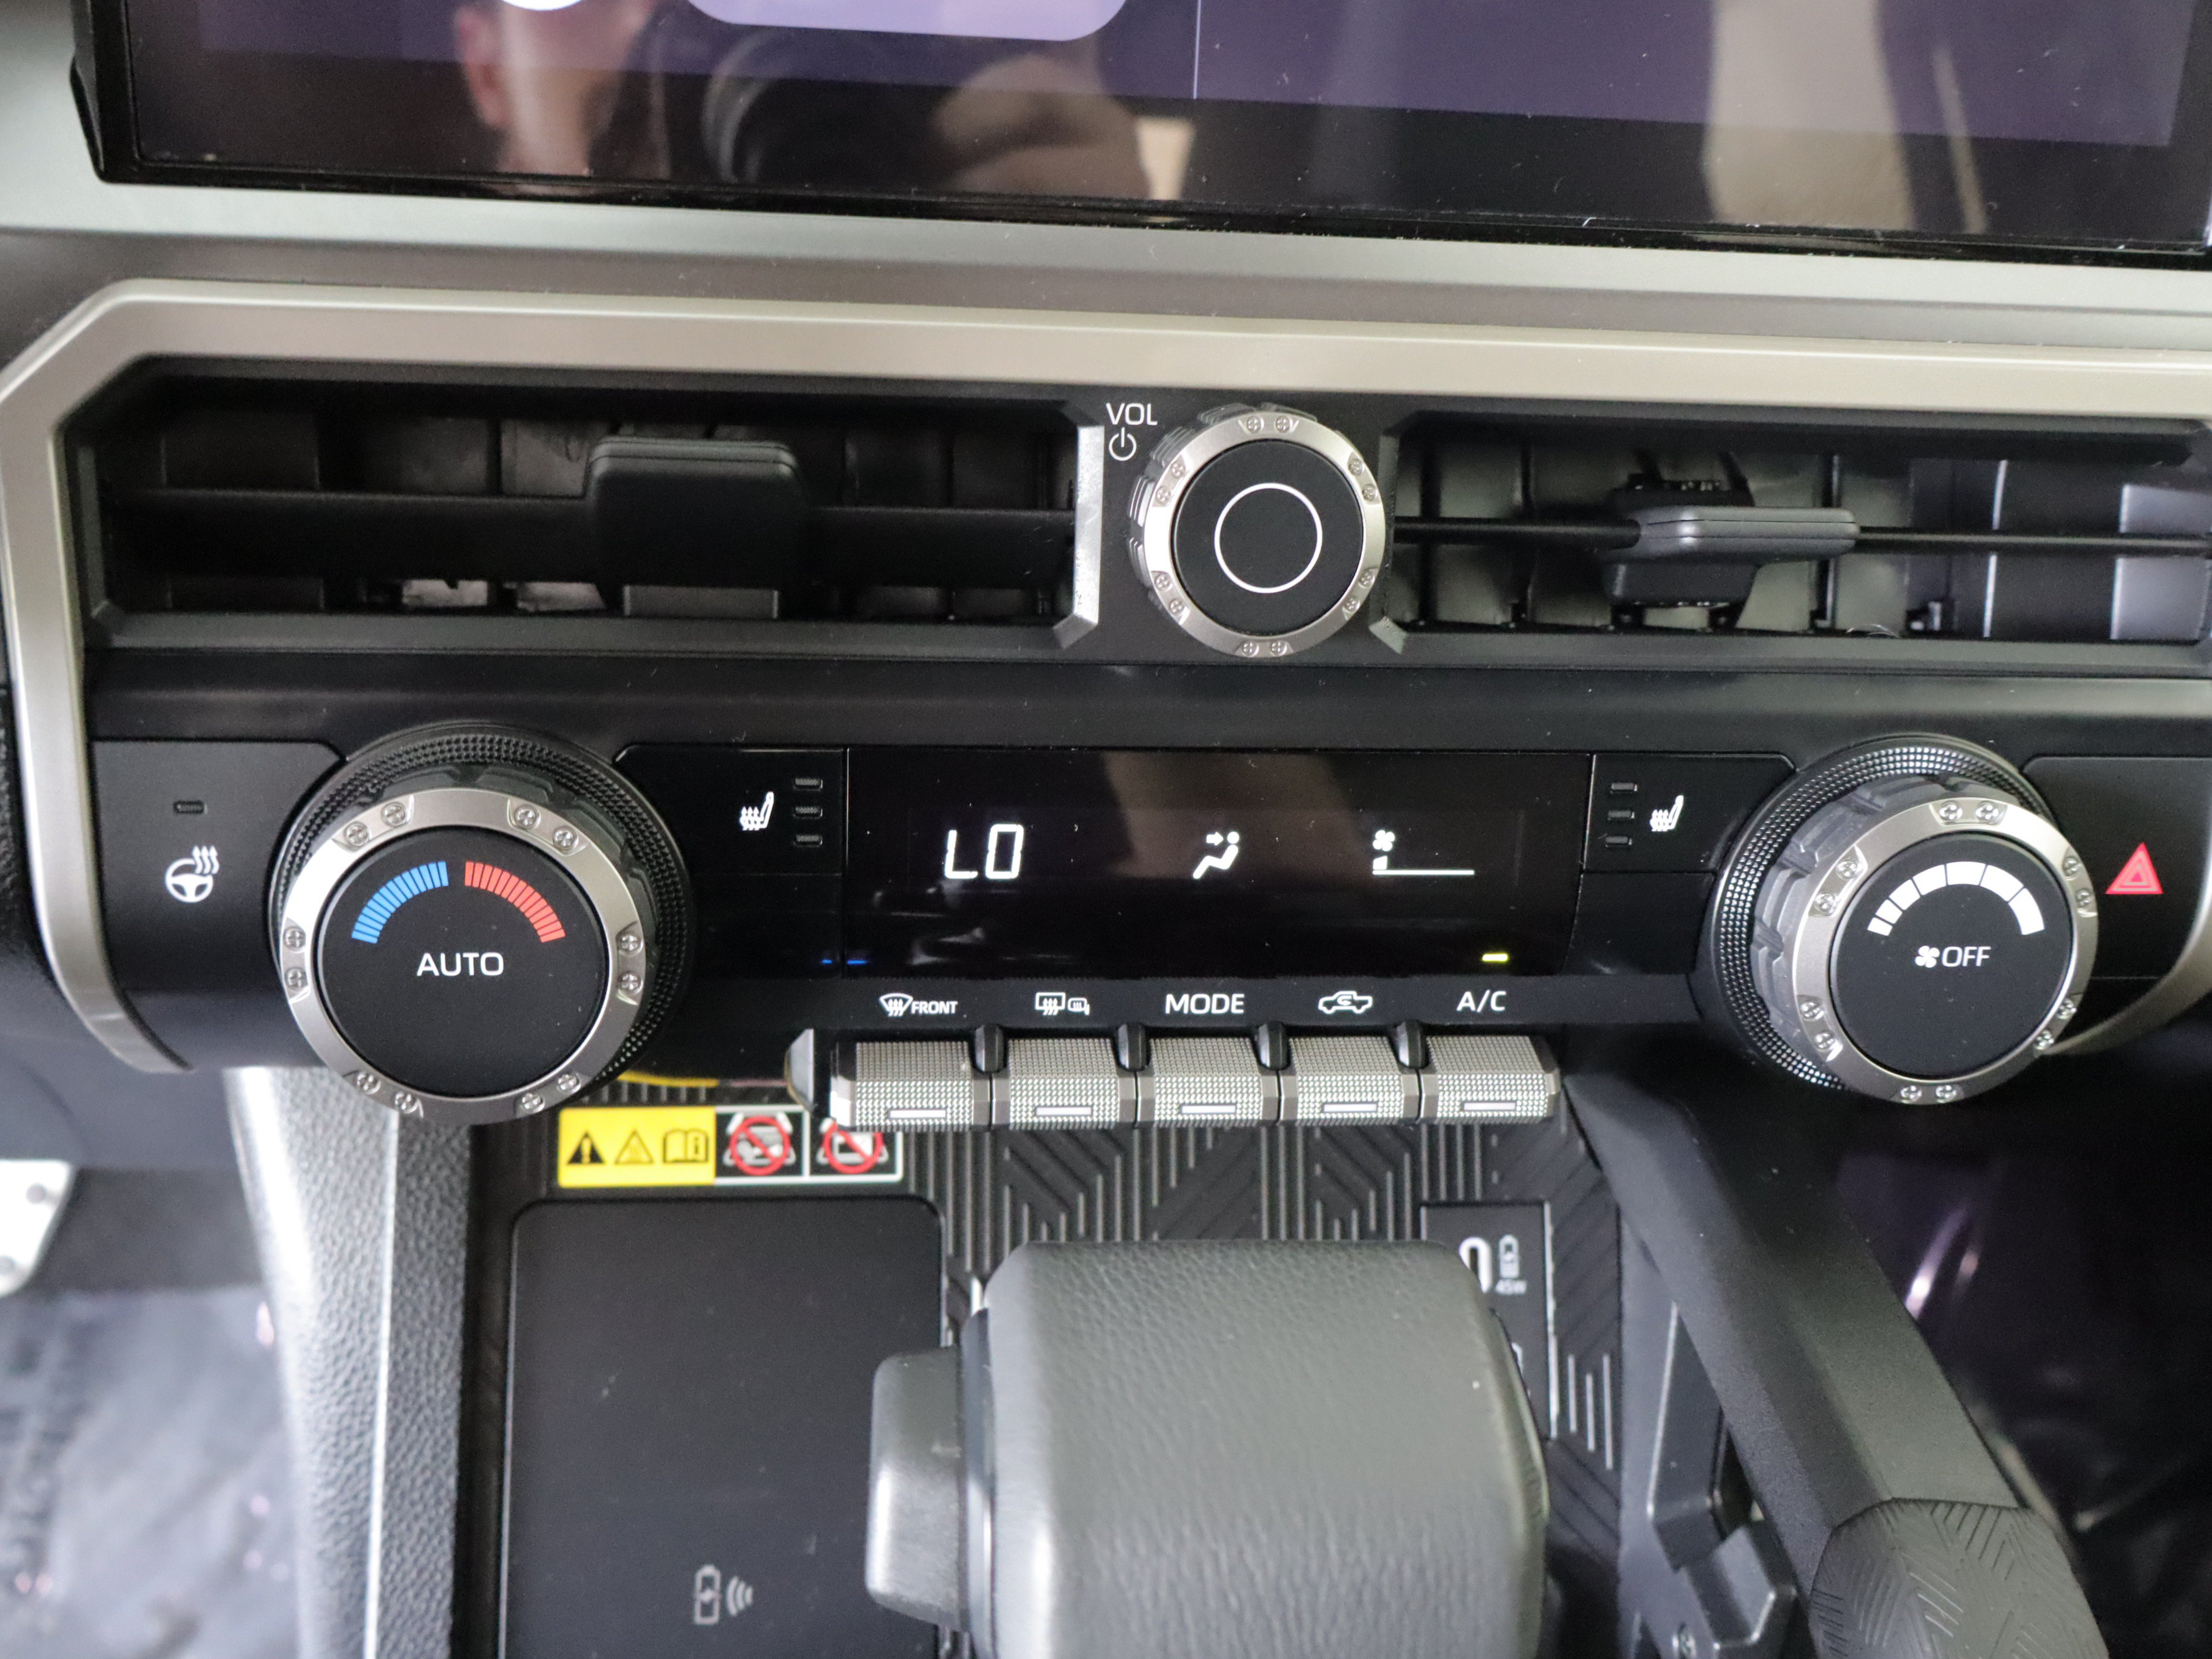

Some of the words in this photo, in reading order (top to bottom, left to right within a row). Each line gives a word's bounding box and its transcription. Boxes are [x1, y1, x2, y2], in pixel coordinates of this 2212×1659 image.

[1105, 402, 1158, 426] VOL
[943, 823, 1024, 880] LO
[416, 952, 504, 977] AUTO
[1941, 945, 1992, 968] OFF
[911, 1000, 958, 1014] FRONT
[1165, 993, 1245, 1015] MODE
[1456, 990, 1507, 1013] A/C
